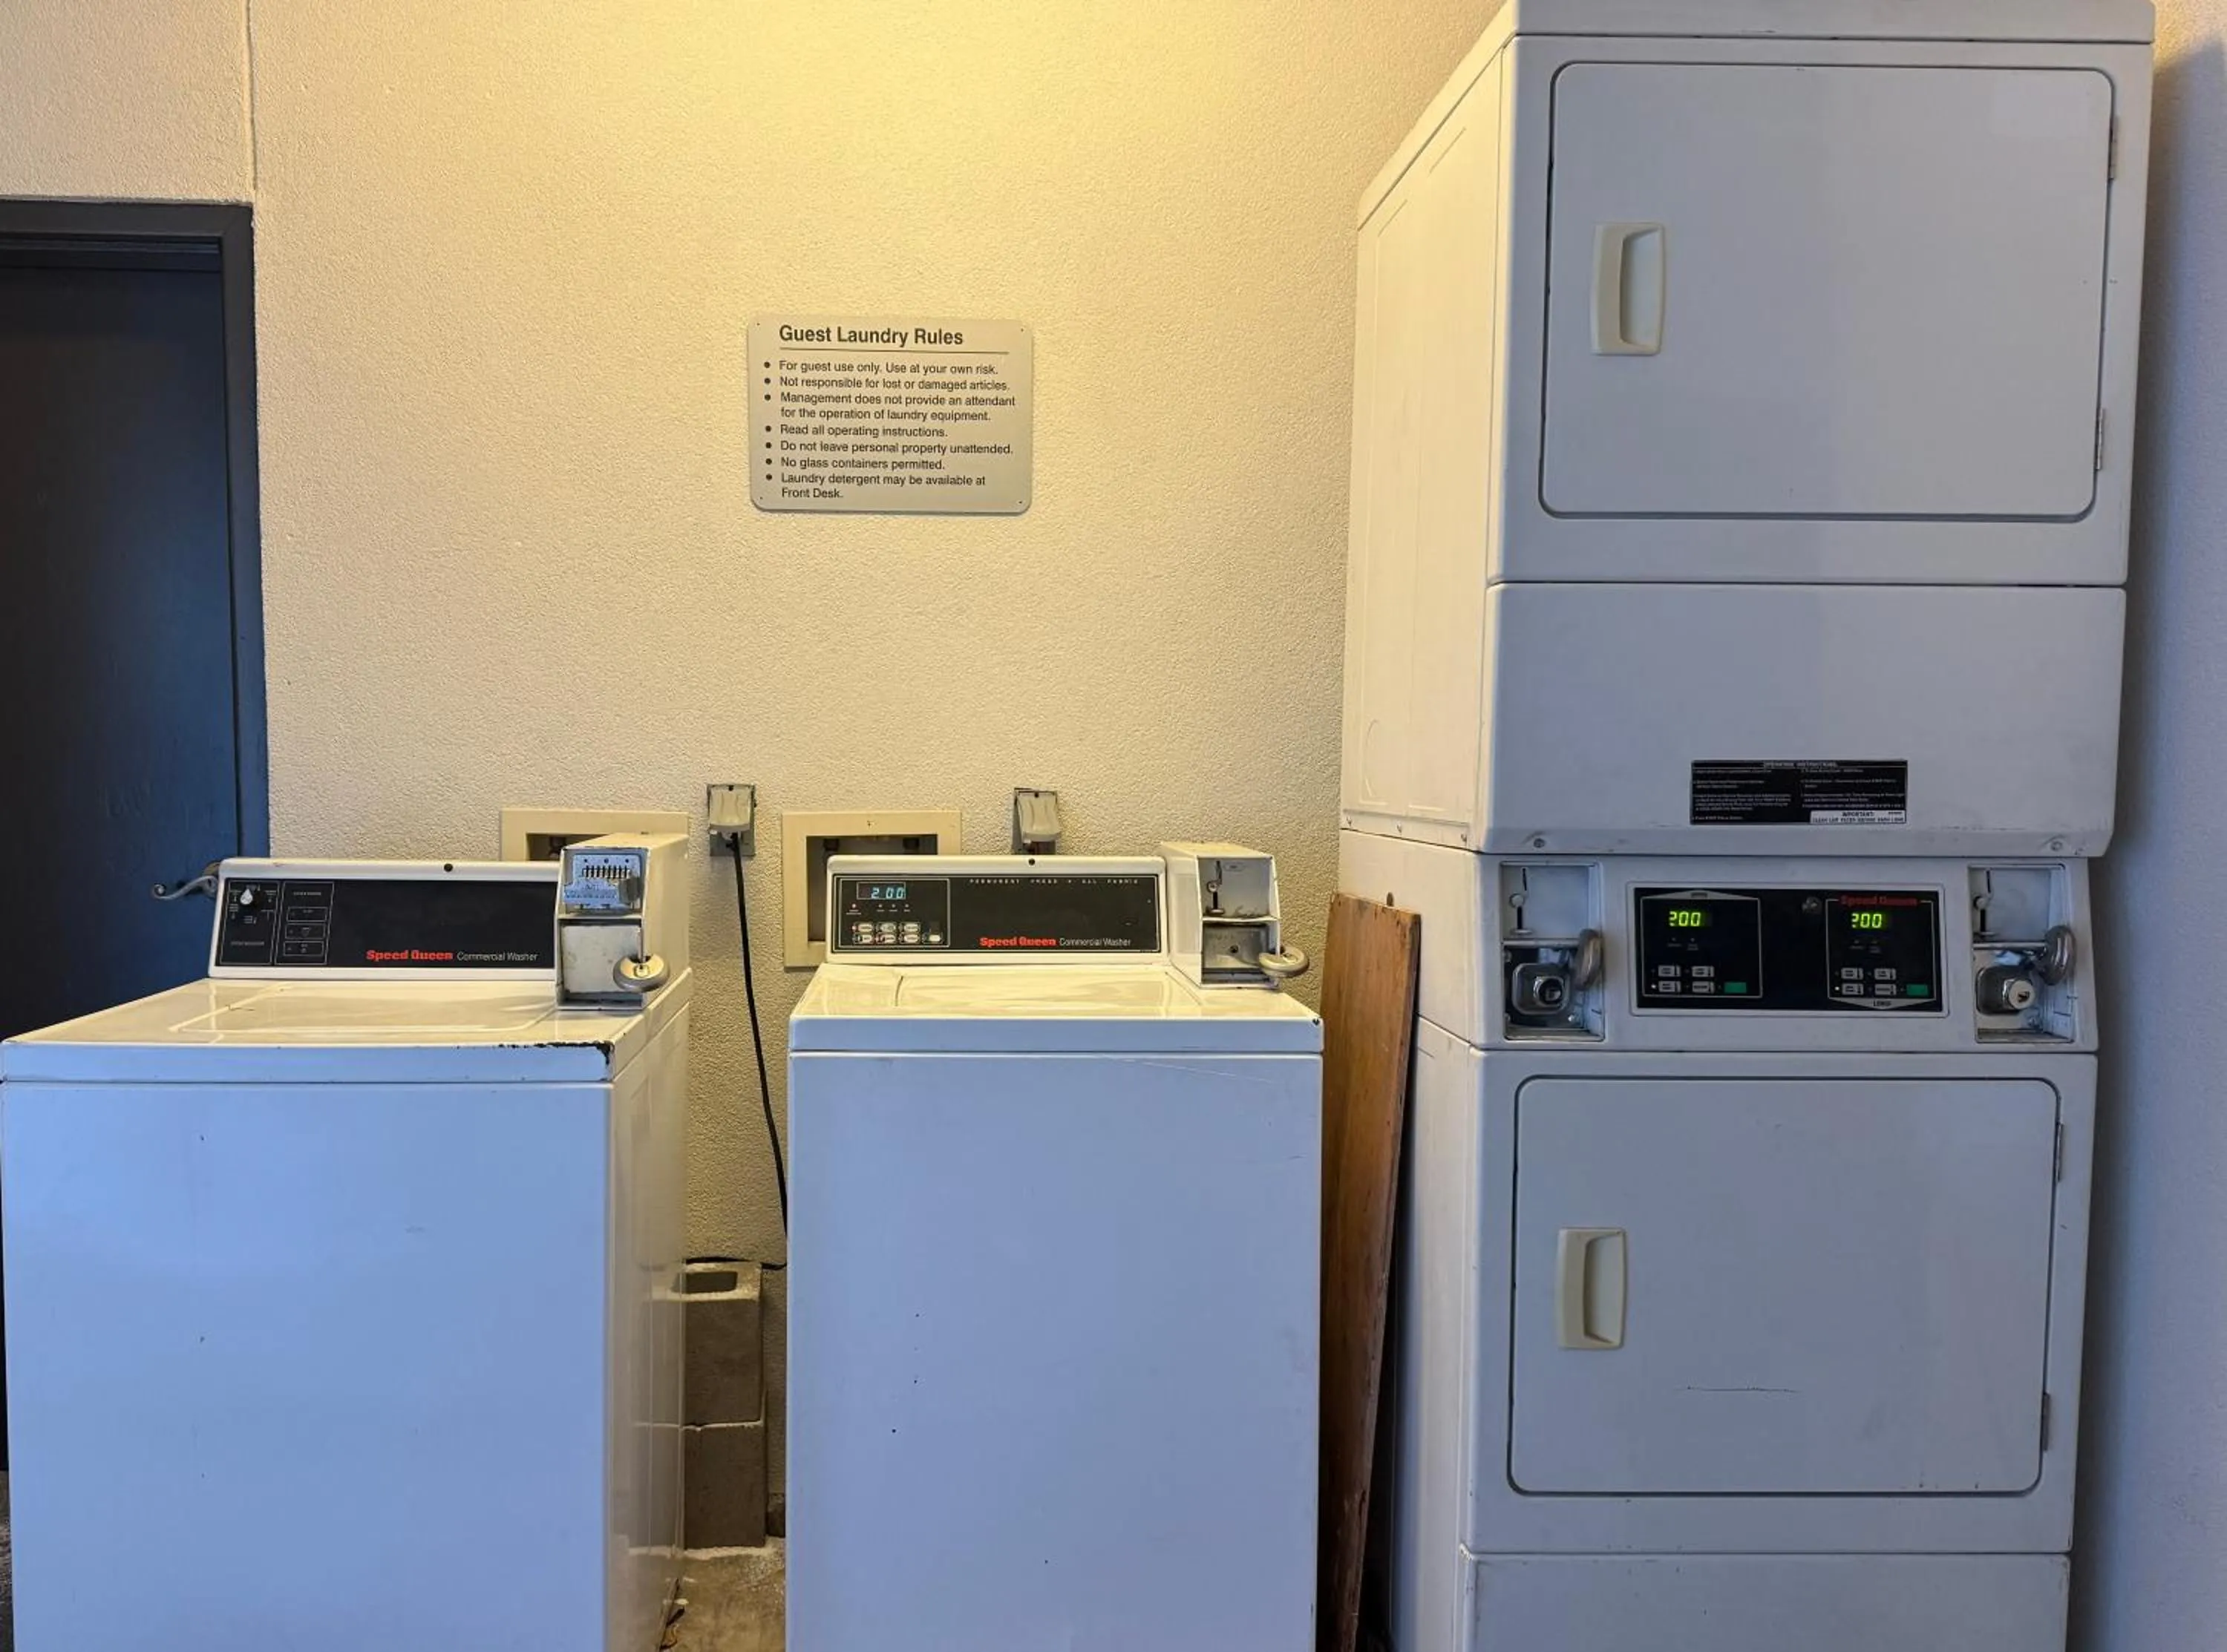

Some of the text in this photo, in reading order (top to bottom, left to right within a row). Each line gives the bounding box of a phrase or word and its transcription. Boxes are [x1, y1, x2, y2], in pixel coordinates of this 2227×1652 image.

[779, 325, 963, 347] Guest Laundry Rules
[779, 360, 998, 376] For guest use only. Use at your own risk.
[779, 376, 1010, 392] Not responsible for lost or damaged articles.
[781, 392, 1016, 407] Management does not provide an attendant
[781, 407, 990, 422] for the operation of laundry equipment.
[780, 424, 947, 438] Read all operating instructions.
[780, 440, 1013, 456] Do not leave personal property unattended.
[781, 456, 944, 471] No glass containers permitted.
[781, 473, 985, 487] Laundry detergent may be available at
[782, 487, 843, 498] Front Desk.
[980, 936, 1132, 948] Speed Queen Commercial Washer
[366, 949, 538, 962] Speed Queen Commercial Washer
